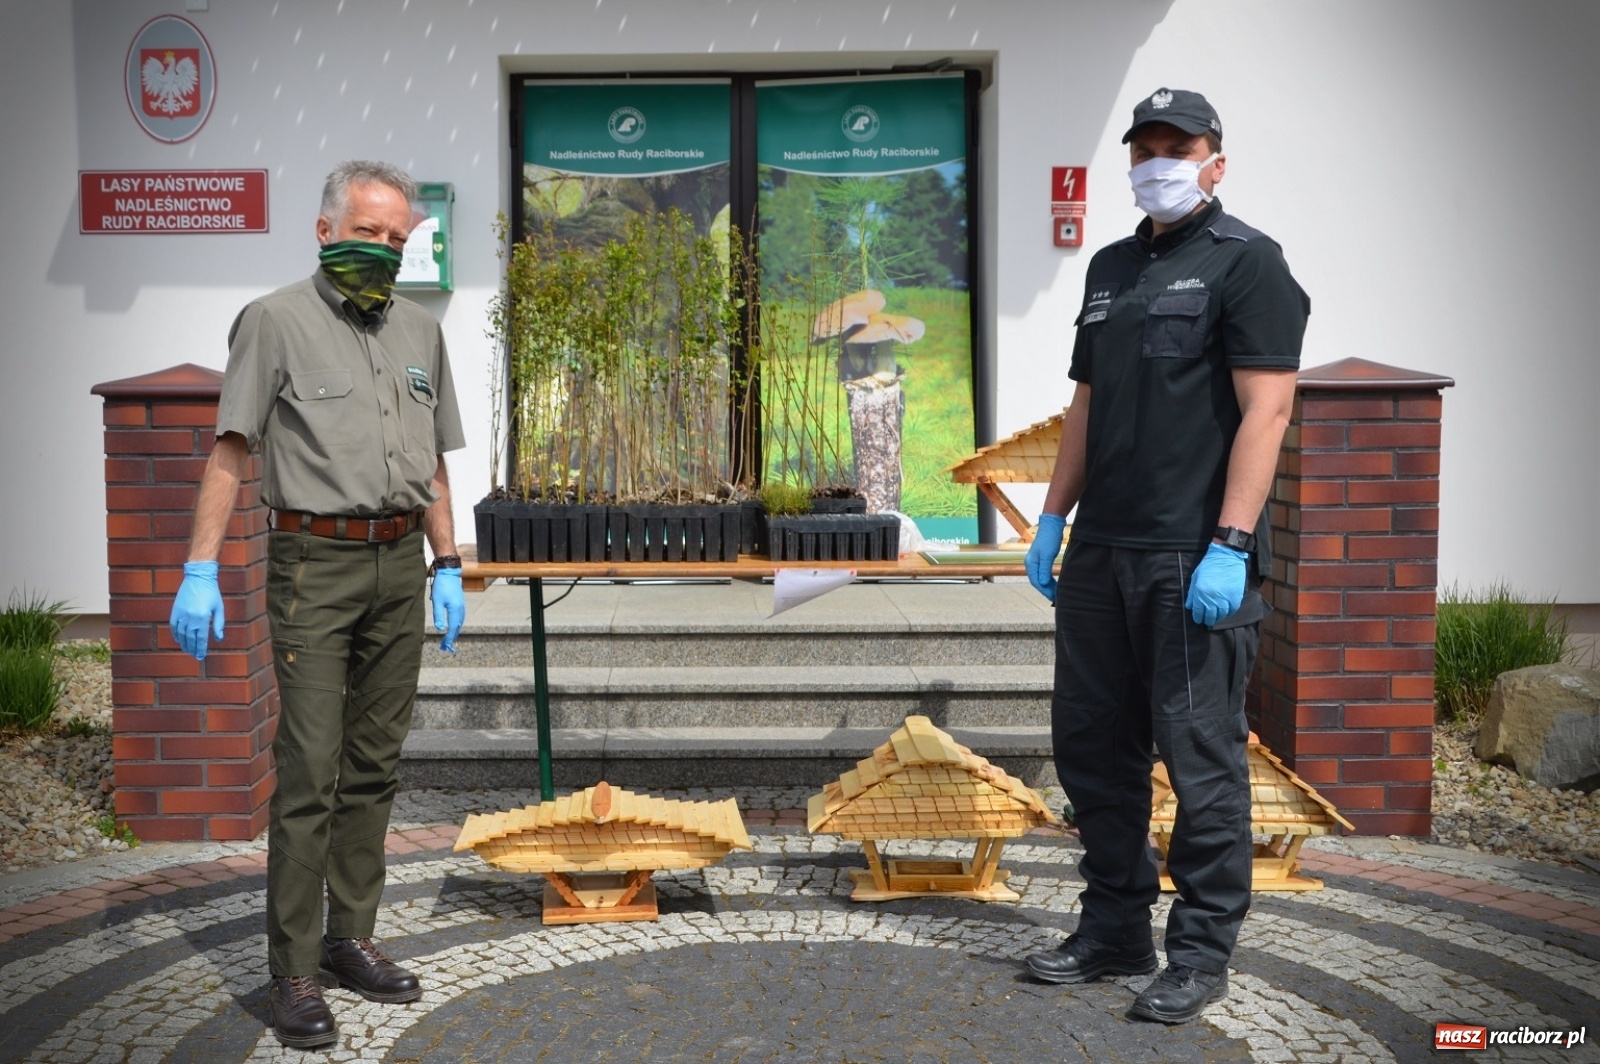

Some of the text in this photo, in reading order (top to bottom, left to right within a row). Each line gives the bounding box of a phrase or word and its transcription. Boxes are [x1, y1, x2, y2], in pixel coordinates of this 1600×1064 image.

[549, 148, 705, 160] Nadleśnictwo Rudy Raciborskie
[784, 146, 940, 161] Nadleśnictwo Rudy Raciborskie
[101, 175, 245, 192] LASY PAŃSTWOWE
[115, 196, 232, 212] NADLEŚNICTWO
[102, 215, 246, 229] RUDY RACIBORSKIE
